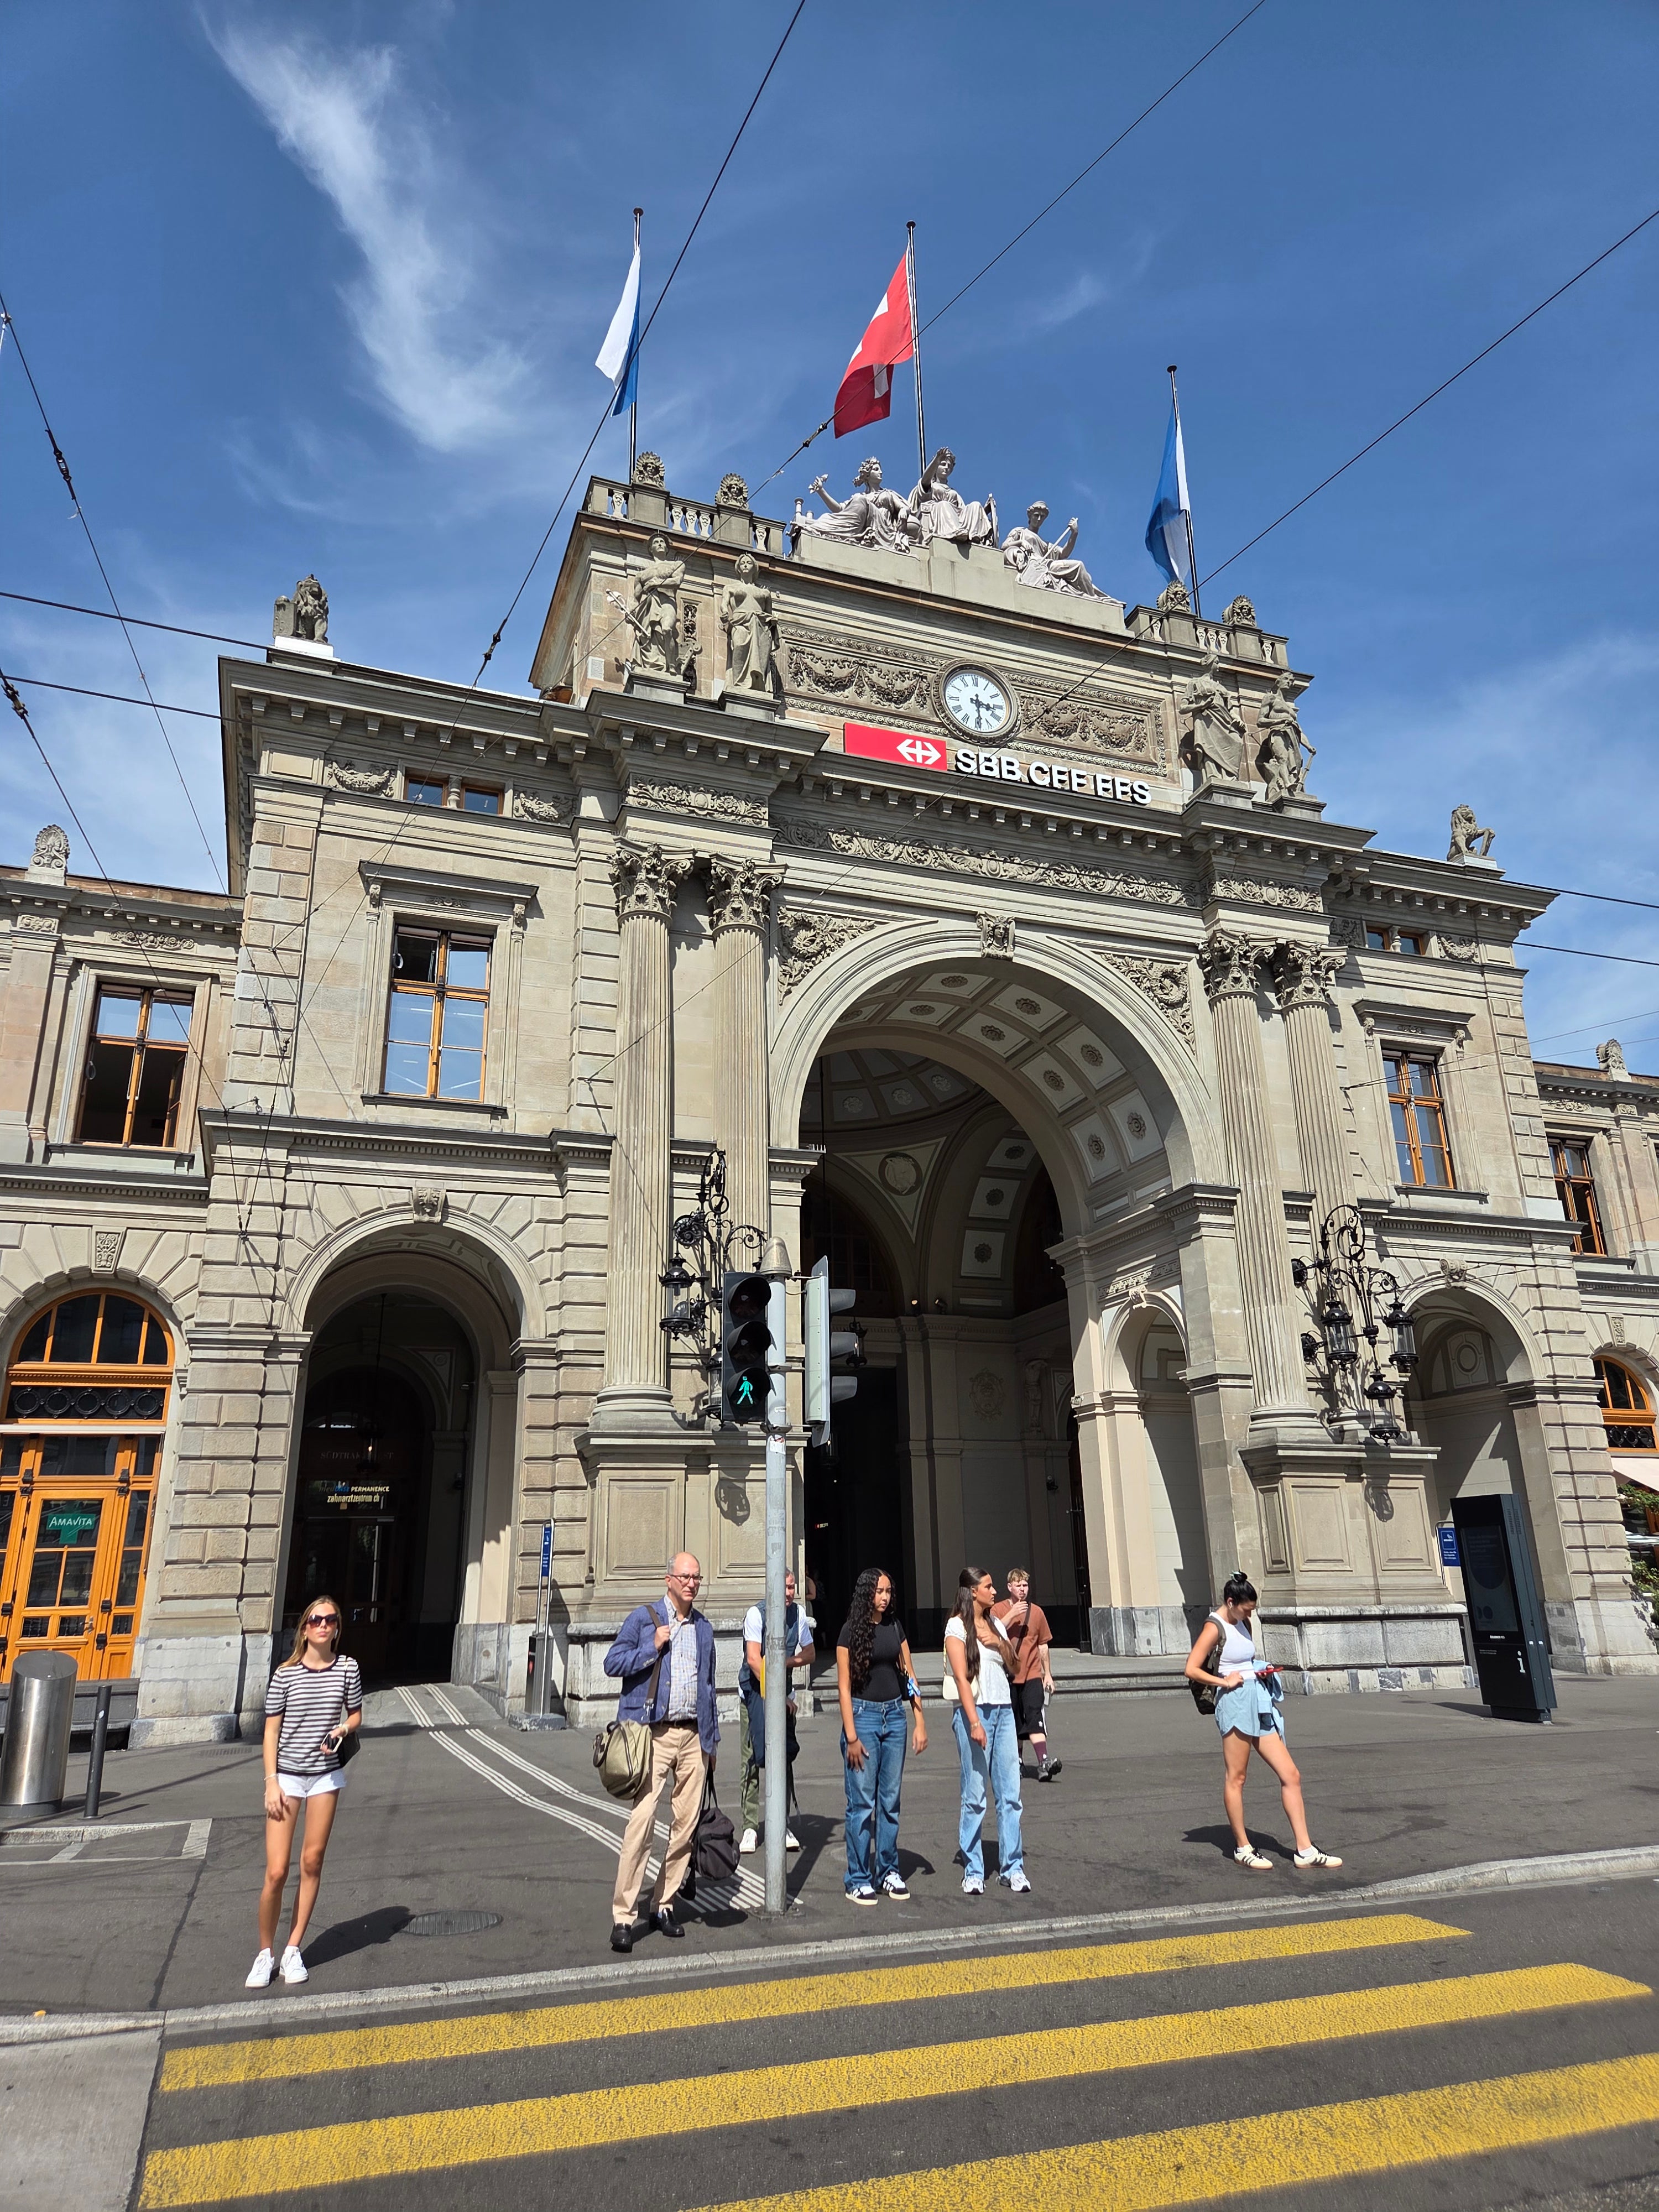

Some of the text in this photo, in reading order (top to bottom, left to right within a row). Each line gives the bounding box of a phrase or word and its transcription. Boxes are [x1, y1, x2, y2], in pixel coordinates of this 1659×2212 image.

[956, 748, 1152, 805] SBB CFF FFS
[49, 1516, 92, 1528] AMAVITA
